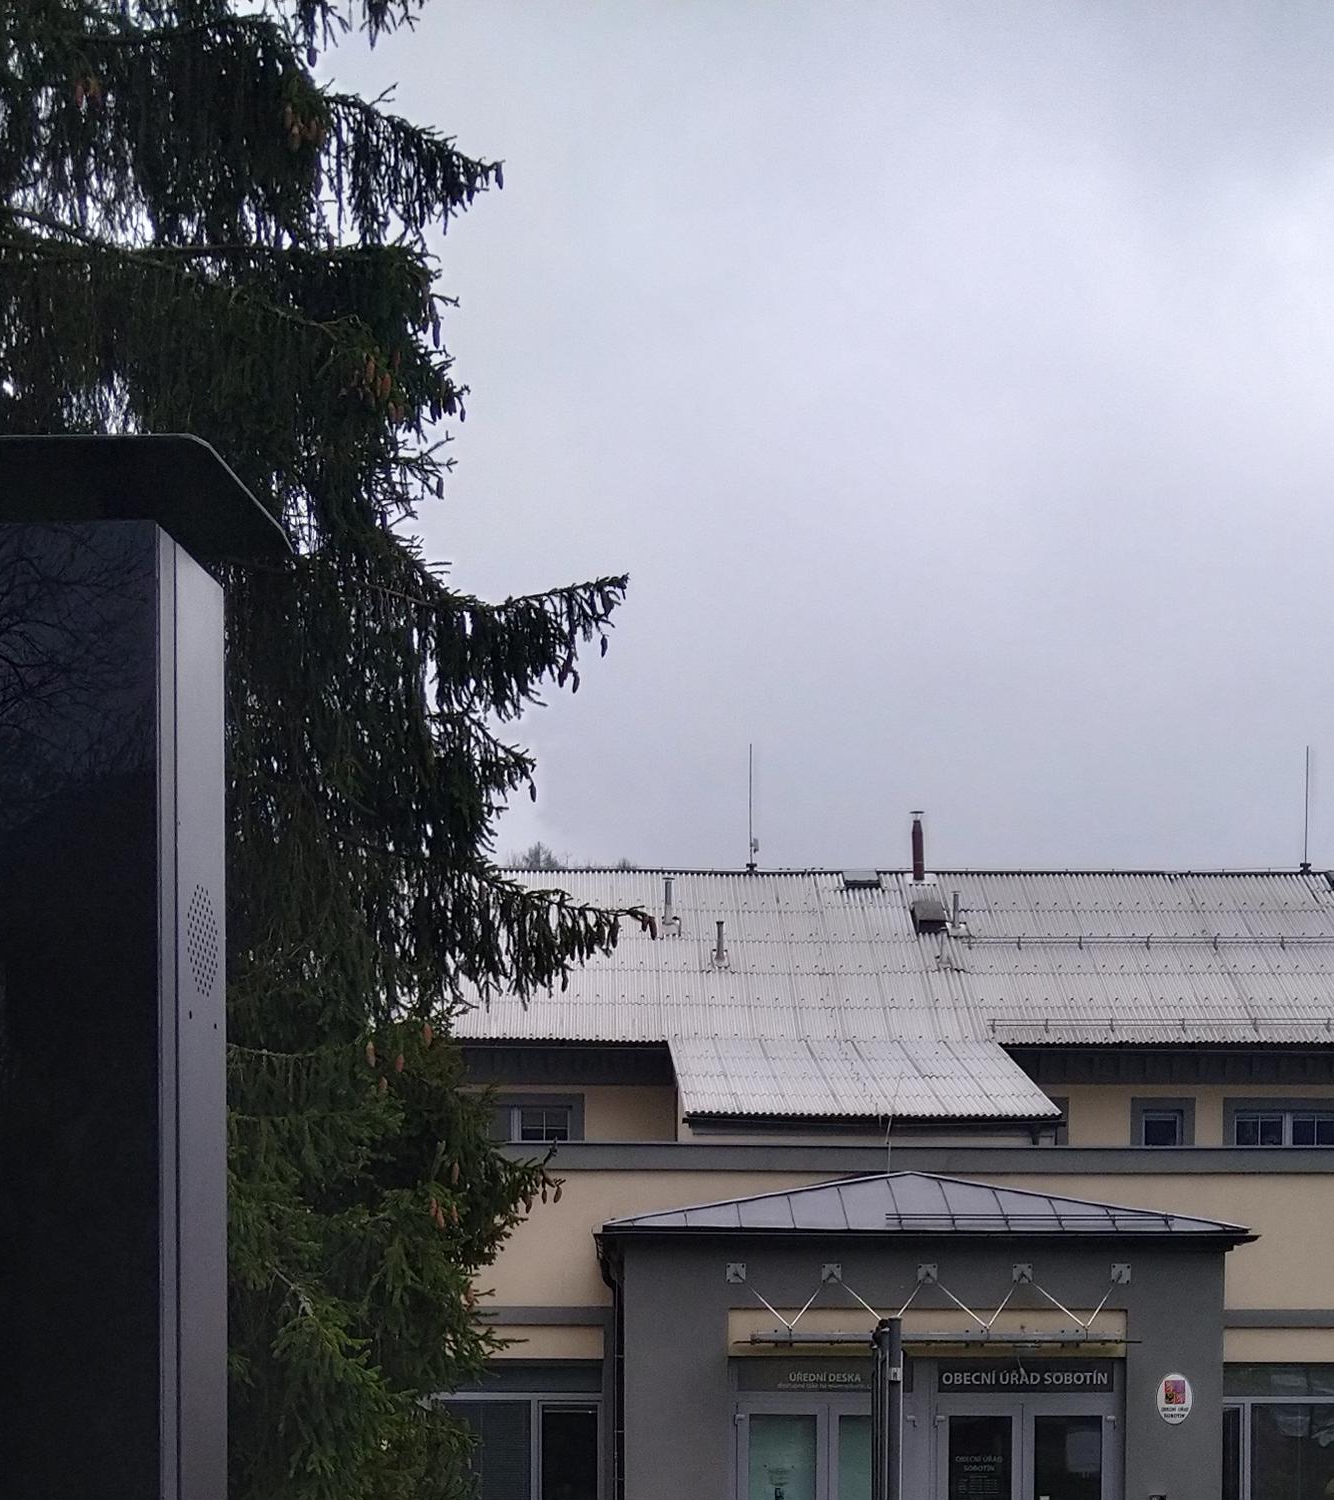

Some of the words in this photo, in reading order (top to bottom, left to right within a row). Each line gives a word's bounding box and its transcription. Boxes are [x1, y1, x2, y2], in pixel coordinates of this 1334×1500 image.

[788, 1370, 827, 1383] ÚŘEDNÍ
[828, 1373, 862, 1383] DESKA
[941, 1370, 996, 1385] OBECNÍ
[999, 1370, 1041, 1385] ÚŘAD
[1043, 1369, 1108, 1385] SOBOTÍN
